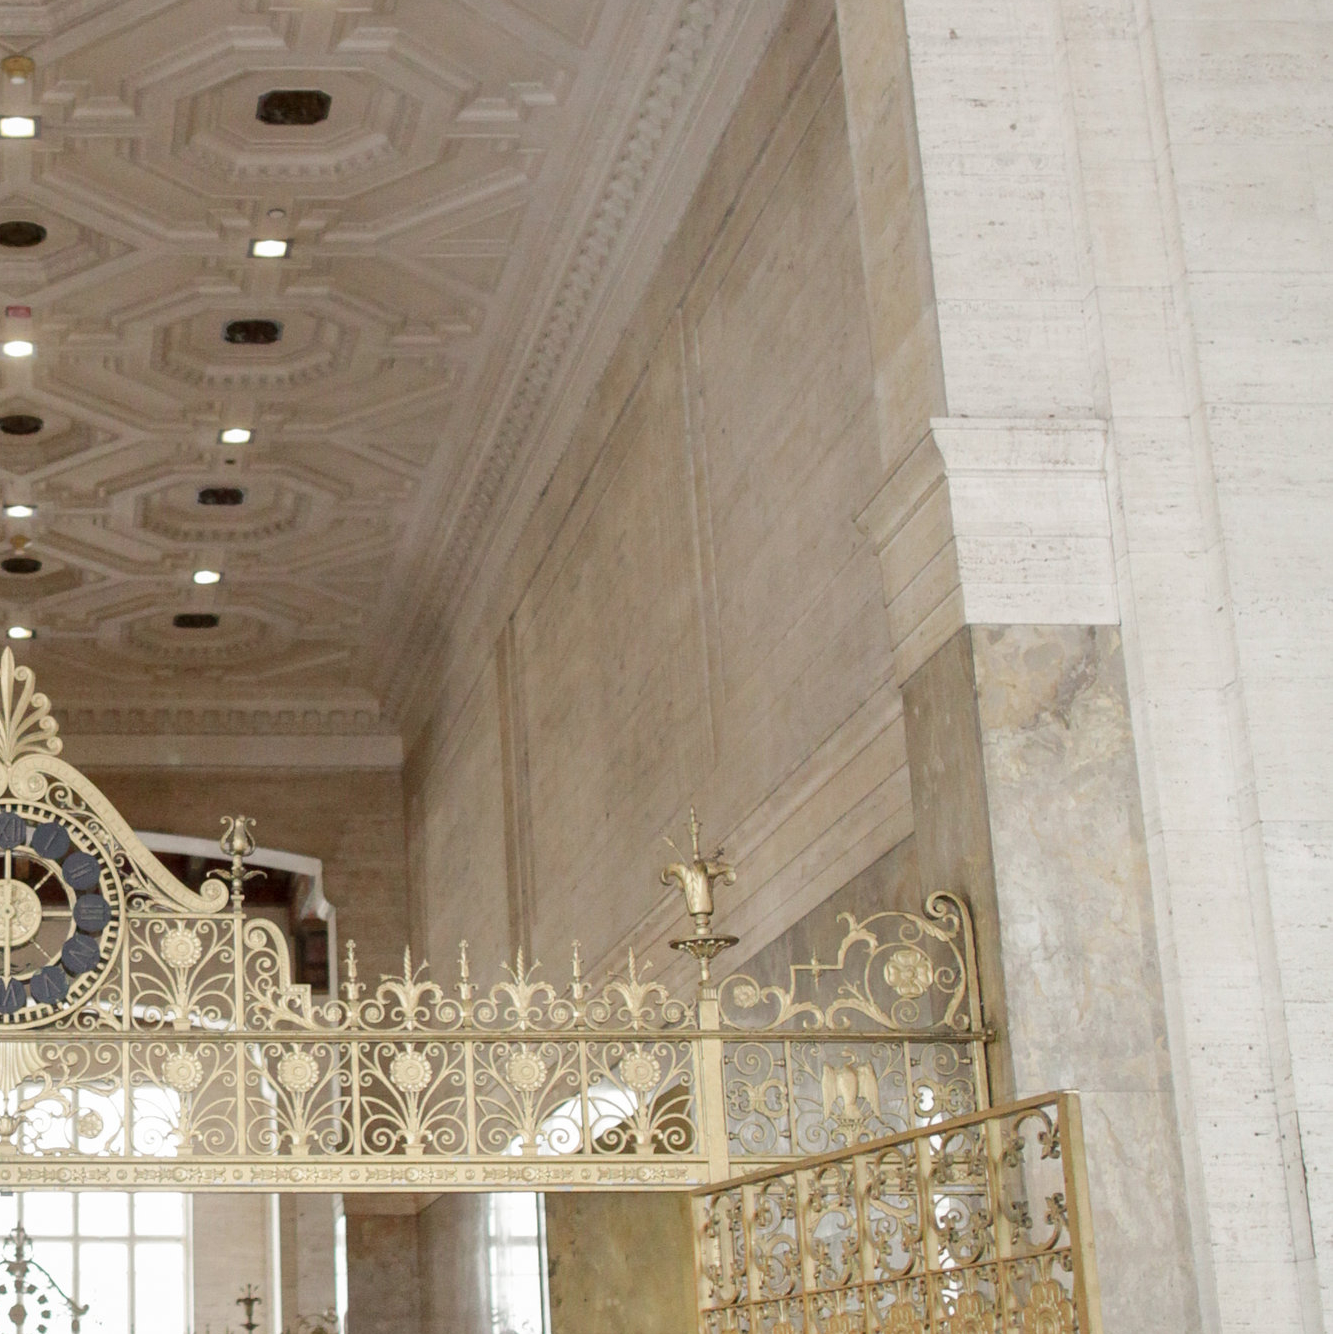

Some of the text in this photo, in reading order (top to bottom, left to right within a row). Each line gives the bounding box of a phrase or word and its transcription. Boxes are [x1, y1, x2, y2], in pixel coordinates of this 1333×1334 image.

[43, 830, 57, 851] I
[68, 862, 92, 879] II
[80, 904, 103, 920] III
[44, 974, 61, 998] V
